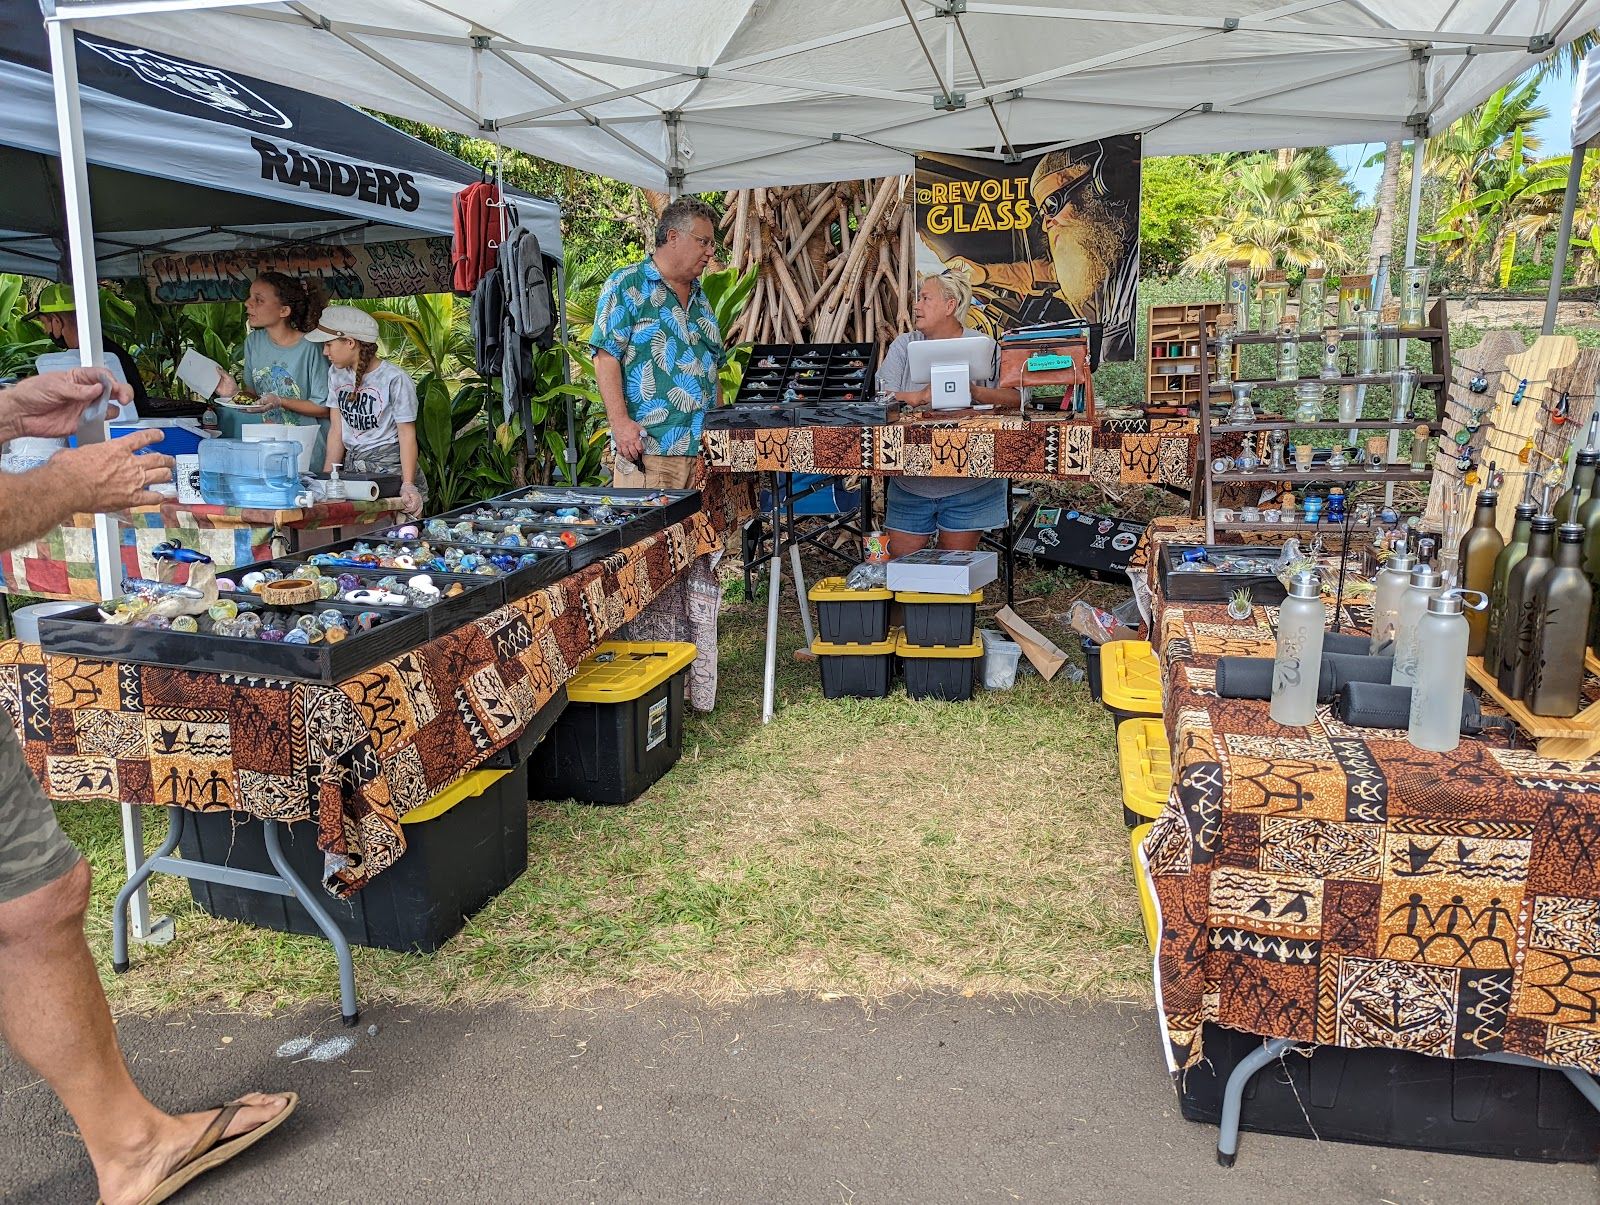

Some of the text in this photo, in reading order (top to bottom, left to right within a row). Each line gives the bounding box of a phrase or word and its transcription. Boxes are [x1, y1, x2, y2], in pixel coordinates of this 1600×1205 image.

[251, 136, 420, 212] RAIDERS
[918, 178, 1029, 204] @REVOLT
[927, 200, 1032, 234] GLASS
[367, 258, 430, 282] CHICKEN
[337, 390, 377, 415] HEART
